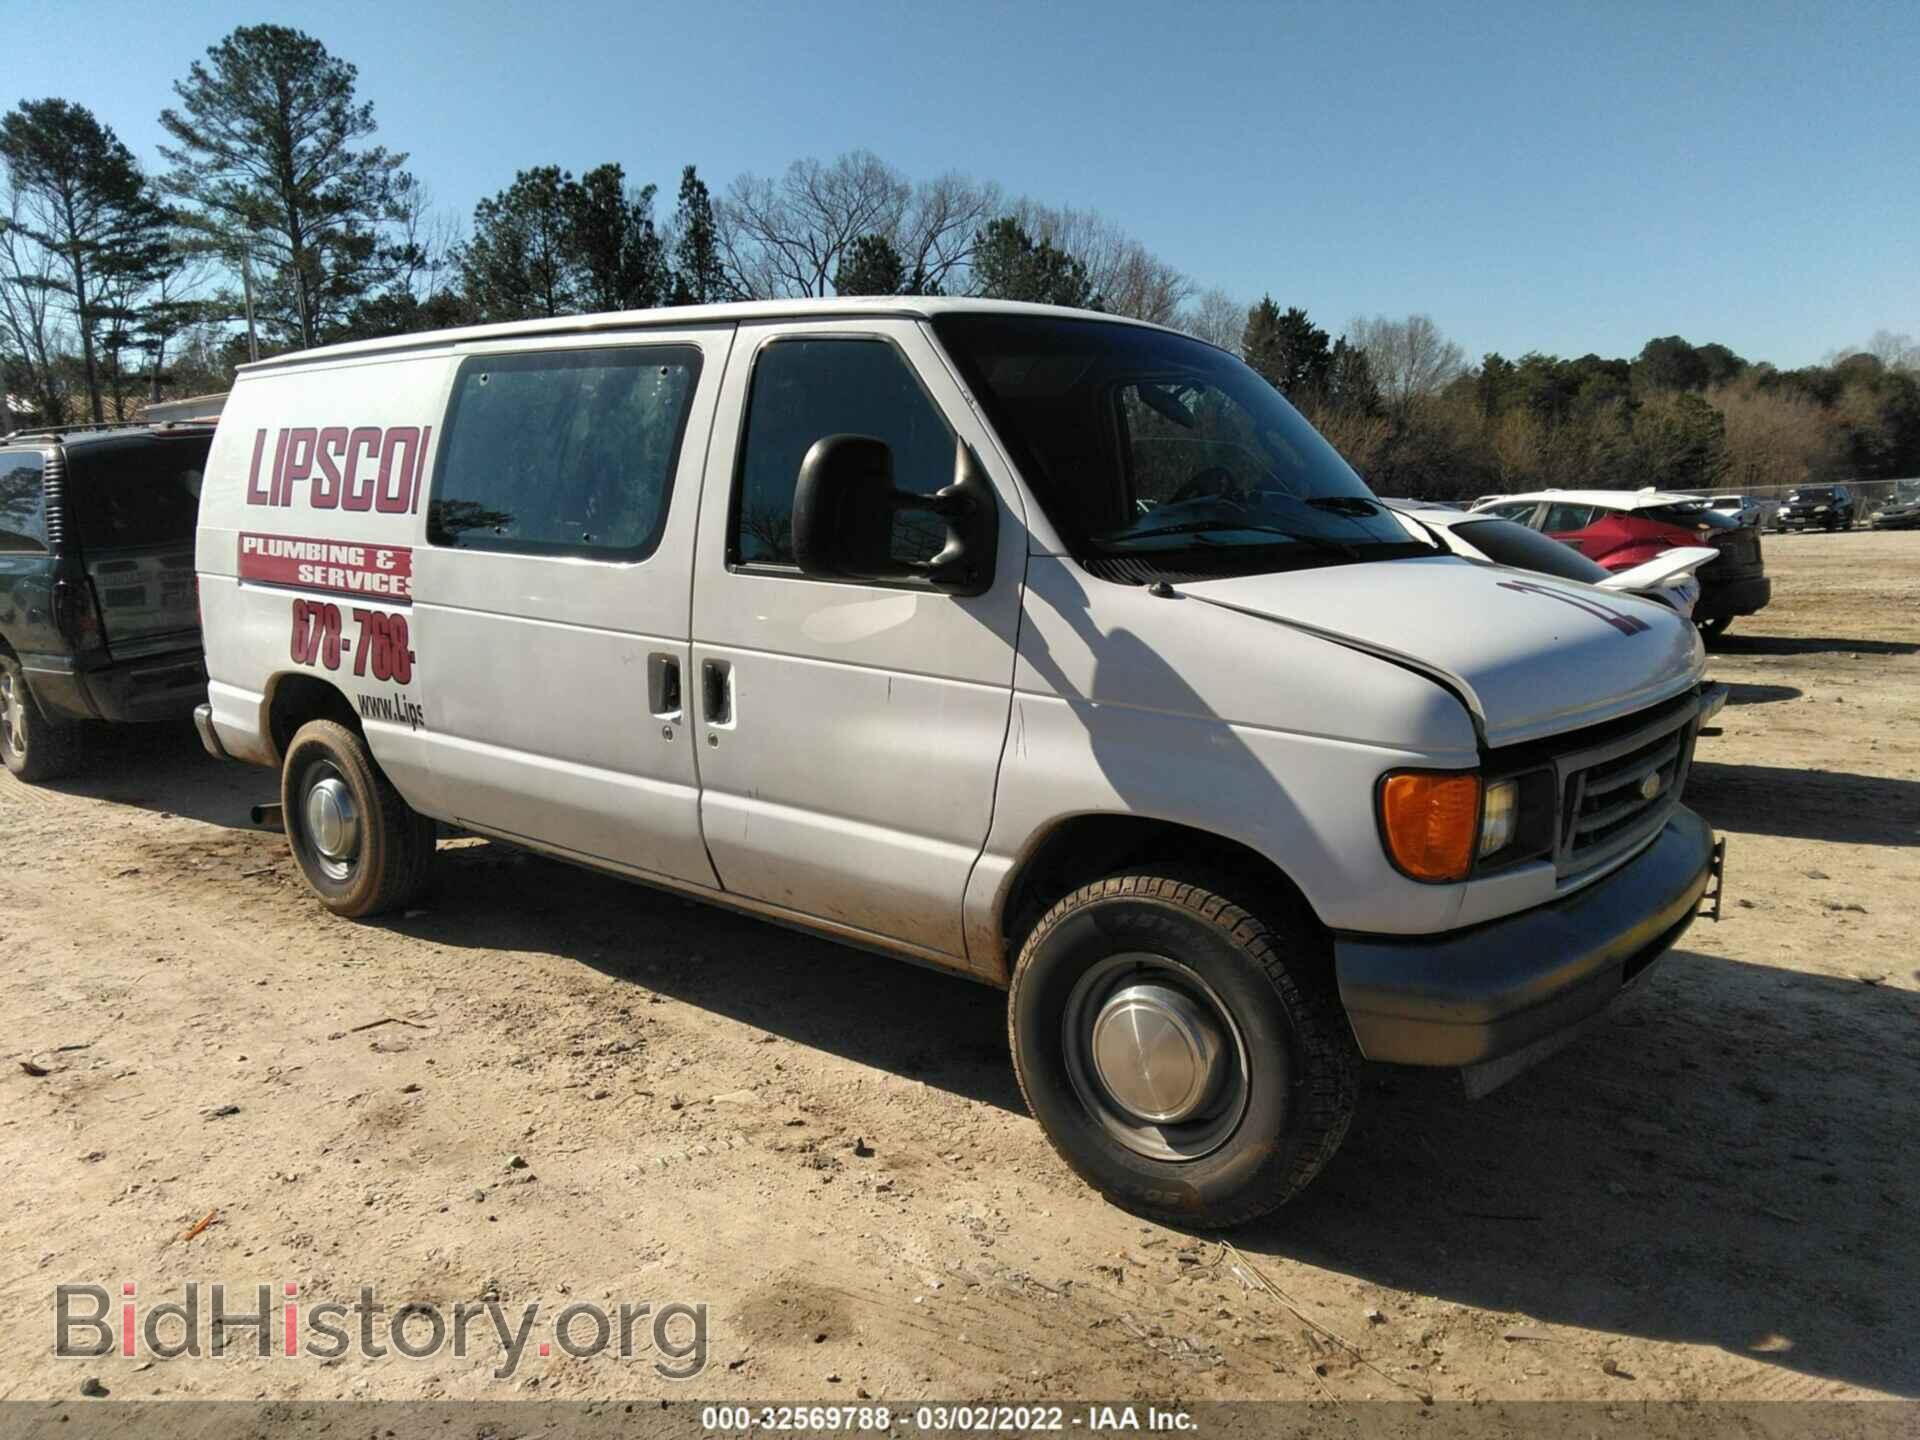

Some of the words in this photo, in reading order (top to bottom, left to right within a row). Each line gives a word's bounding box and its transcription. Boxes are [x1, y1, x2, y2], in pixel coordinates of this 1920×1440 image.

[246, 425, 432, 515] LIPSCO
[242, 536, 365, 567] PLUMBING
[376, 550, 396, 570] &
